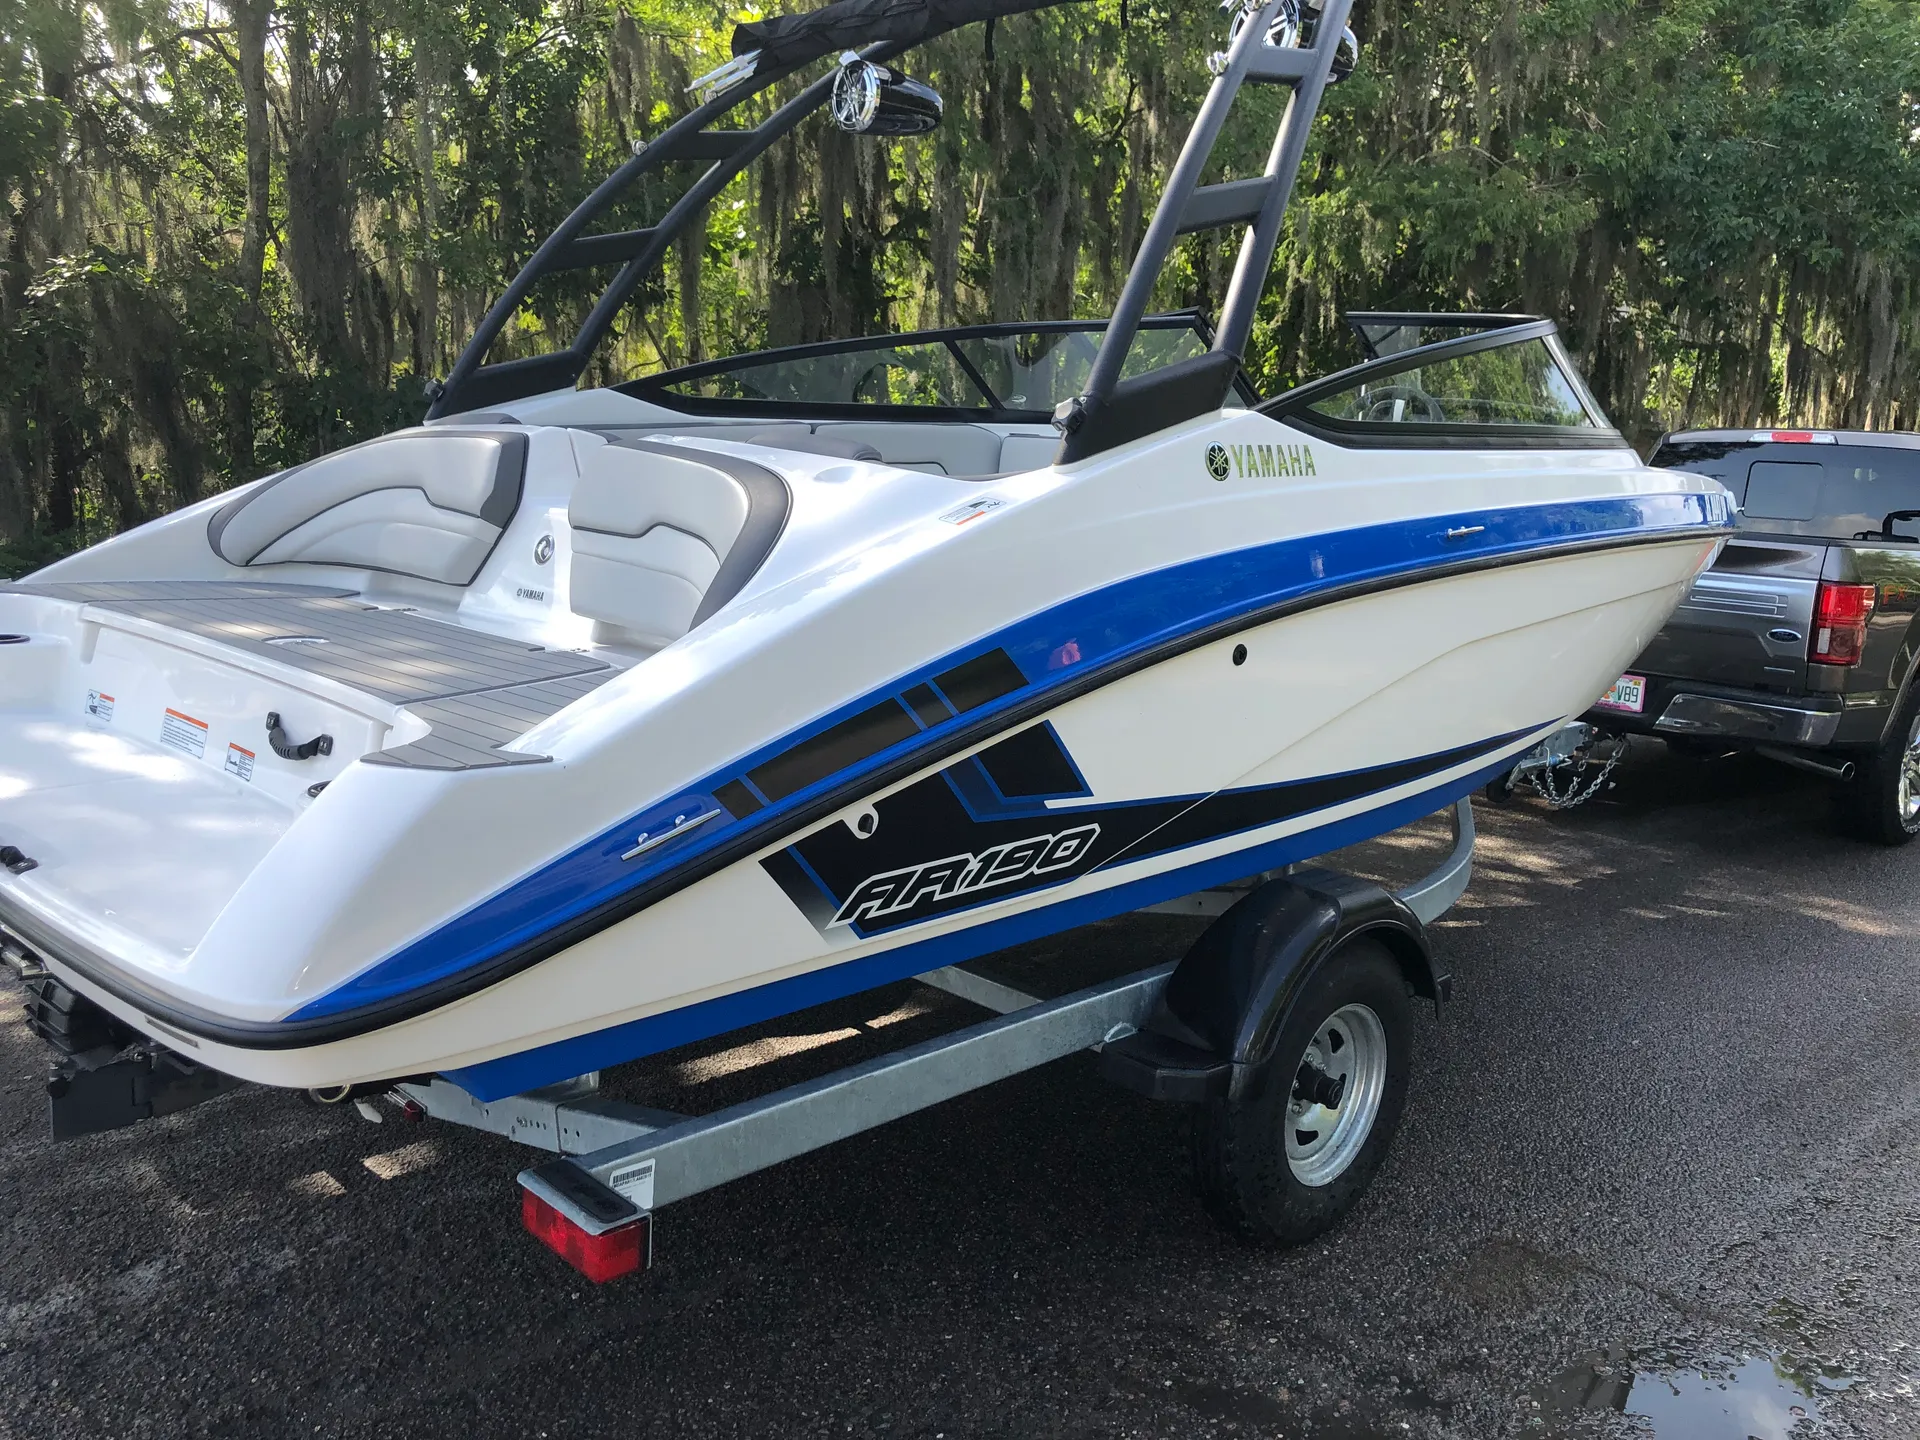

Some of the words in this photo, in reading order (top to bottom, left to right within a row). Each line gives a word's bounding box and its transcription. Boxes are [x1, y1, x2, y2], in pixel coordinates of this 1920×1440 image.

[1230, 444, 1317, 478] YAMAHA
[522, 588, 545, 601] YAMAHA
[1617, 685, 1639, 703] V89
